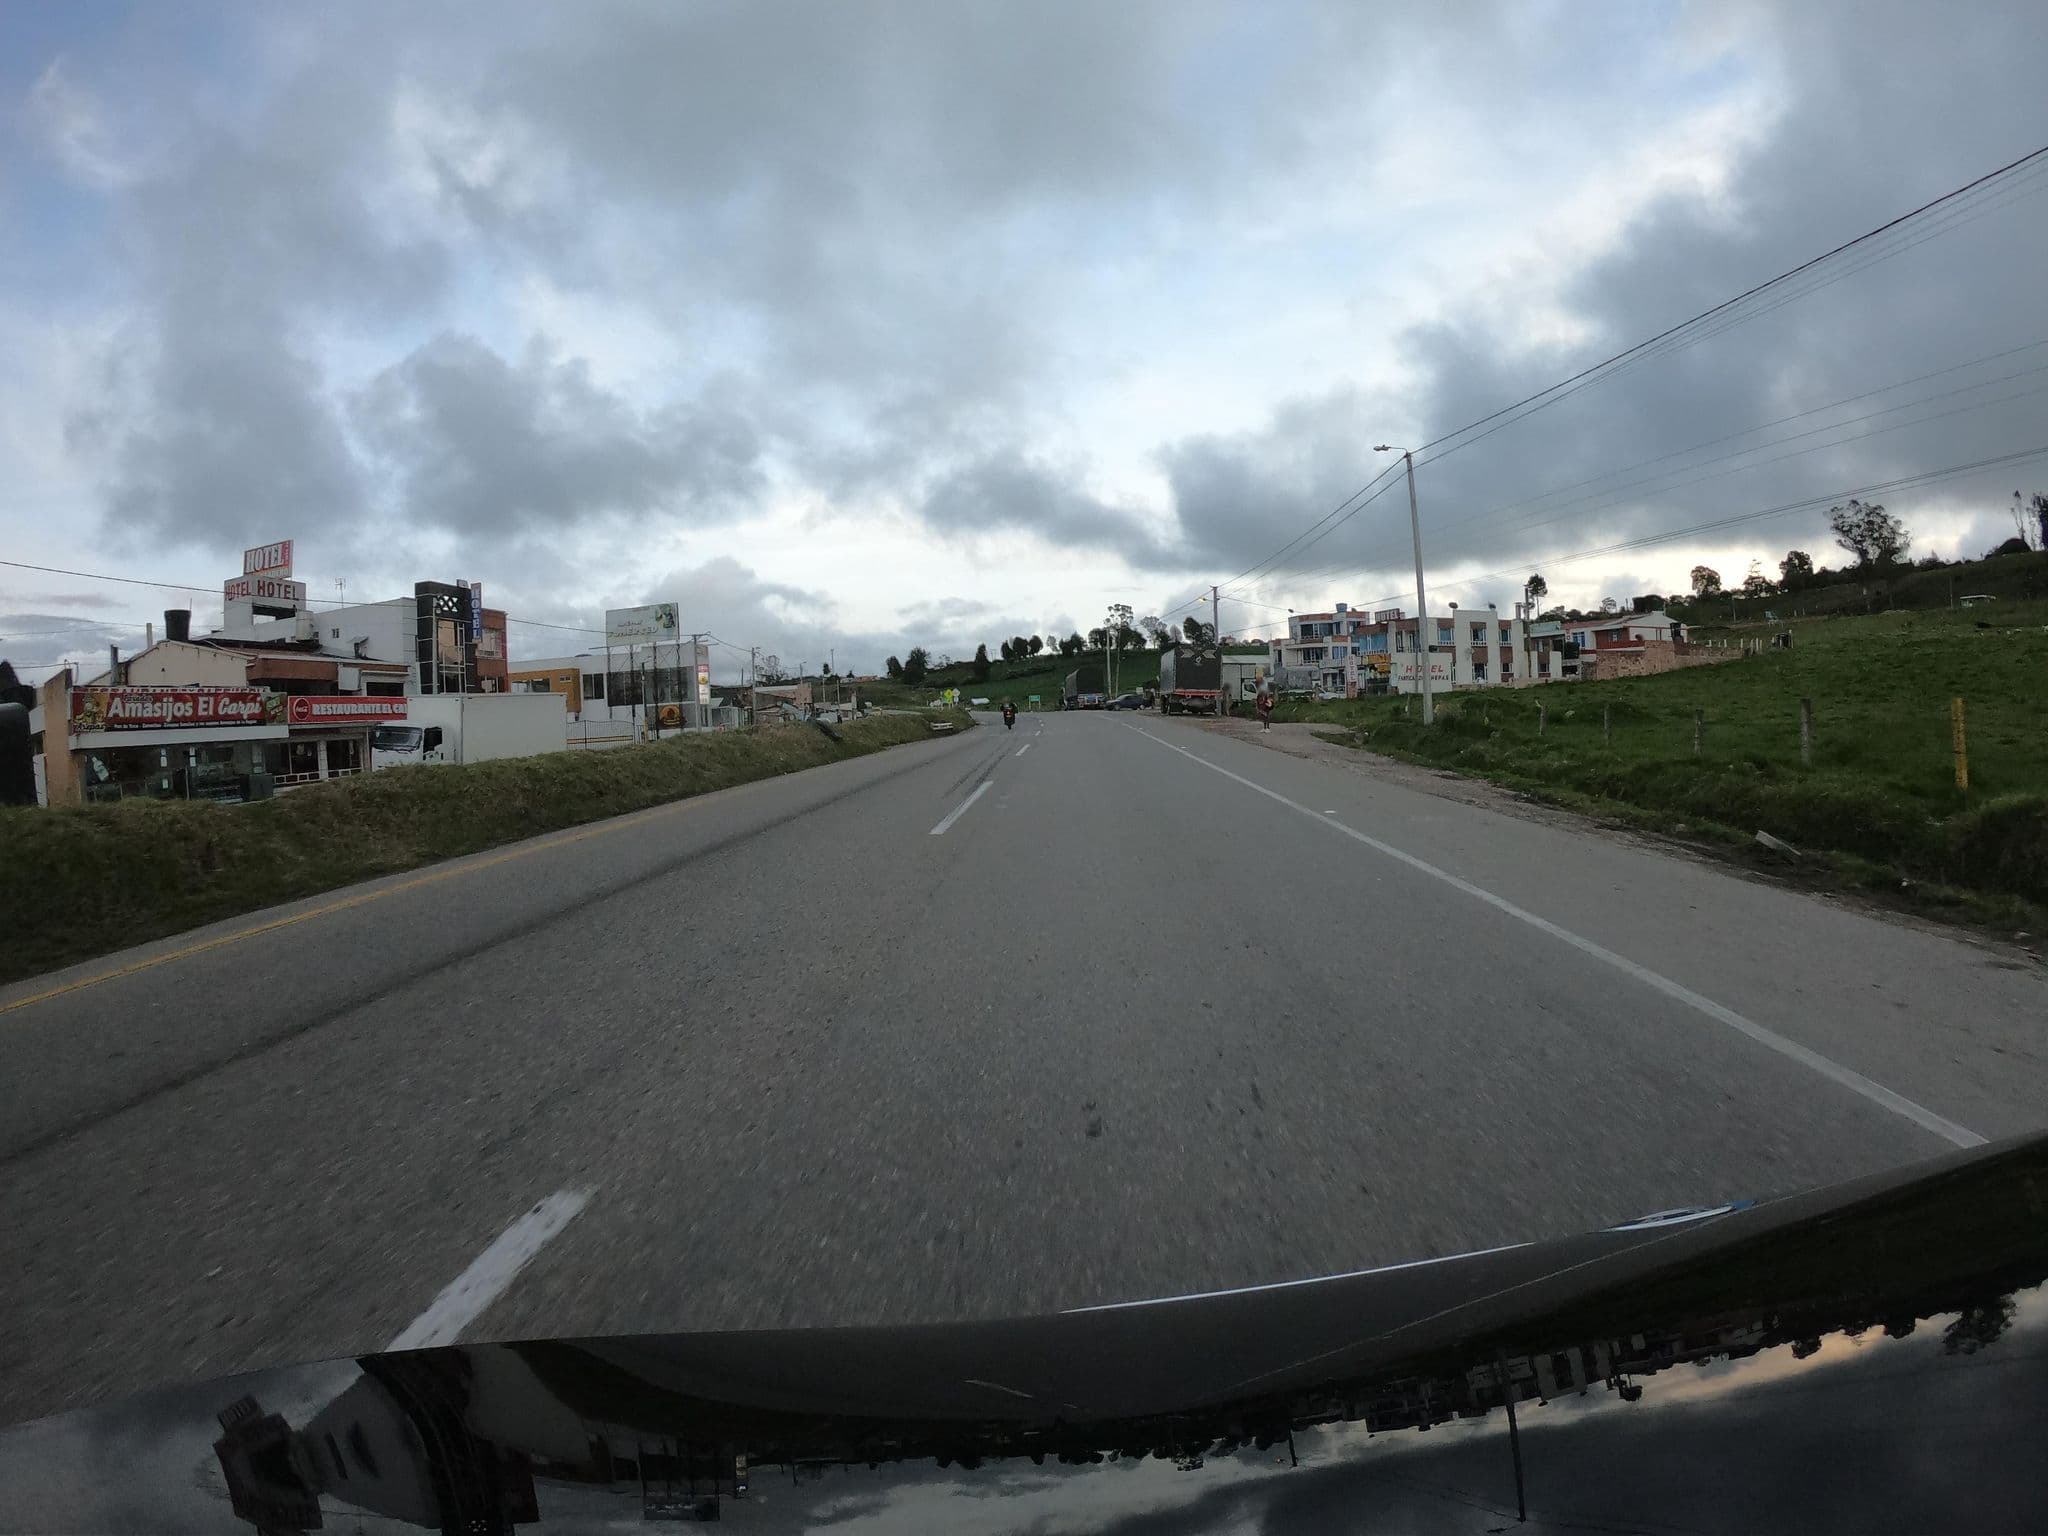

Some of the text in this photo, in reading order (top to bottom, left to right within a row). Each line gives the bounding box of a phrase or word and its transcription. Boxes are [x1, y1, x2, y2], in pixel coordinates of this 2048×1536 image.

[246, 543, 284, 573] HOTEL
[225, 581, 250, 601] HOTEL
[257, 579, 300, 601] HOTEL
[471, 587, 481, 640] HOTEL
[1375, 609, 1400, 622] HOTEL
[1348, 655, 1356, 681] HOTEL
[1405, 664, 1444, 673] HOEL
[107, 697, 193, 722] Amasijos
[198, 696, 214, 716] El
[312, 703, 382, 715] RESTAURANTE
